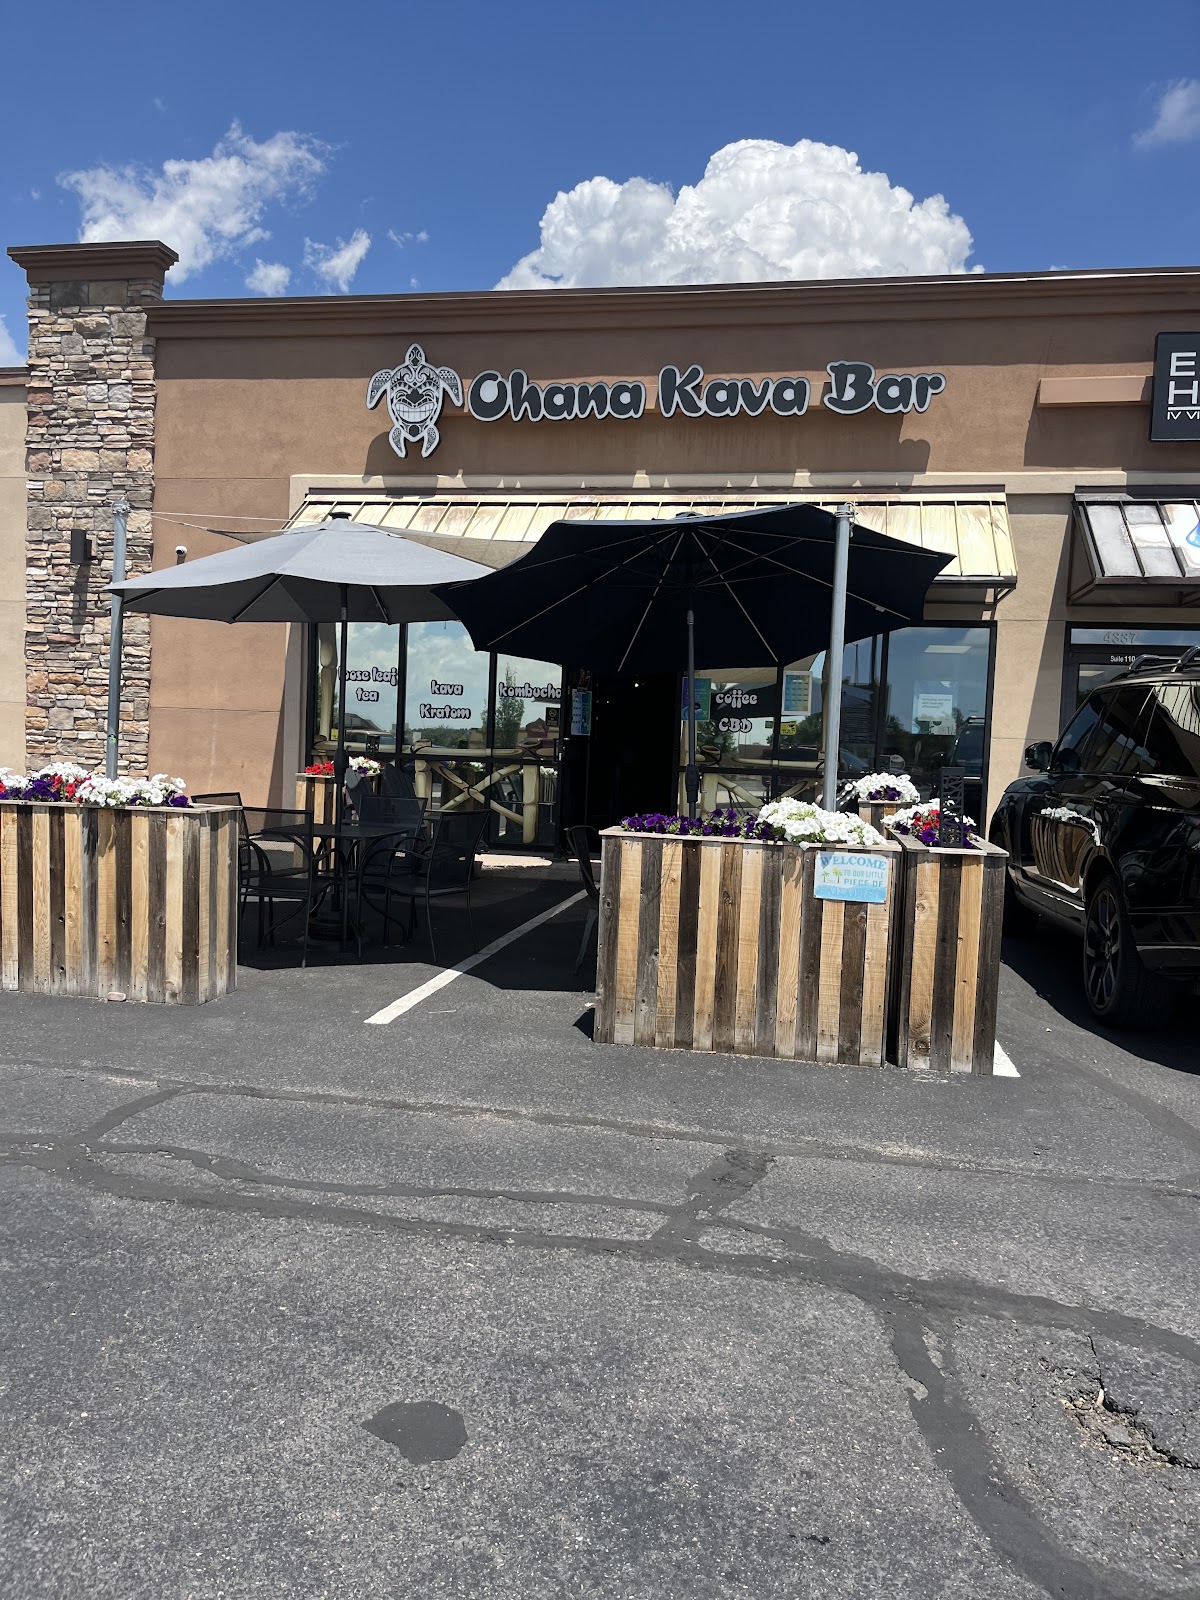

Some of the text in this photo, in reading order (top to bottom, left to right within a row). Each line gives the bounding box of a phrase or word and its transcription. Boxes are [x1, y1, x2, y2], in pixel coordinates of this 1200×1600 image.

[467, 360, 947, 422] Ohana Kava Bar
[1110, 655, 1136, 663] Suite 110
[371, 666, 398, 687] leaf
[356, 687, 379, 702] tea
[430, 679, 464, 695] kava
[715, 689, 758, 709] coffee
[419, 703, 472, 719] Kratom
[718, 717, 753, 734] CBD
[819, 855, 887, 871] WELCOME
[852, 869, 865, 878] OUR
[865, 870, 884, 879] LITTLE
[843, 878, 884, 888] PIECE OF
